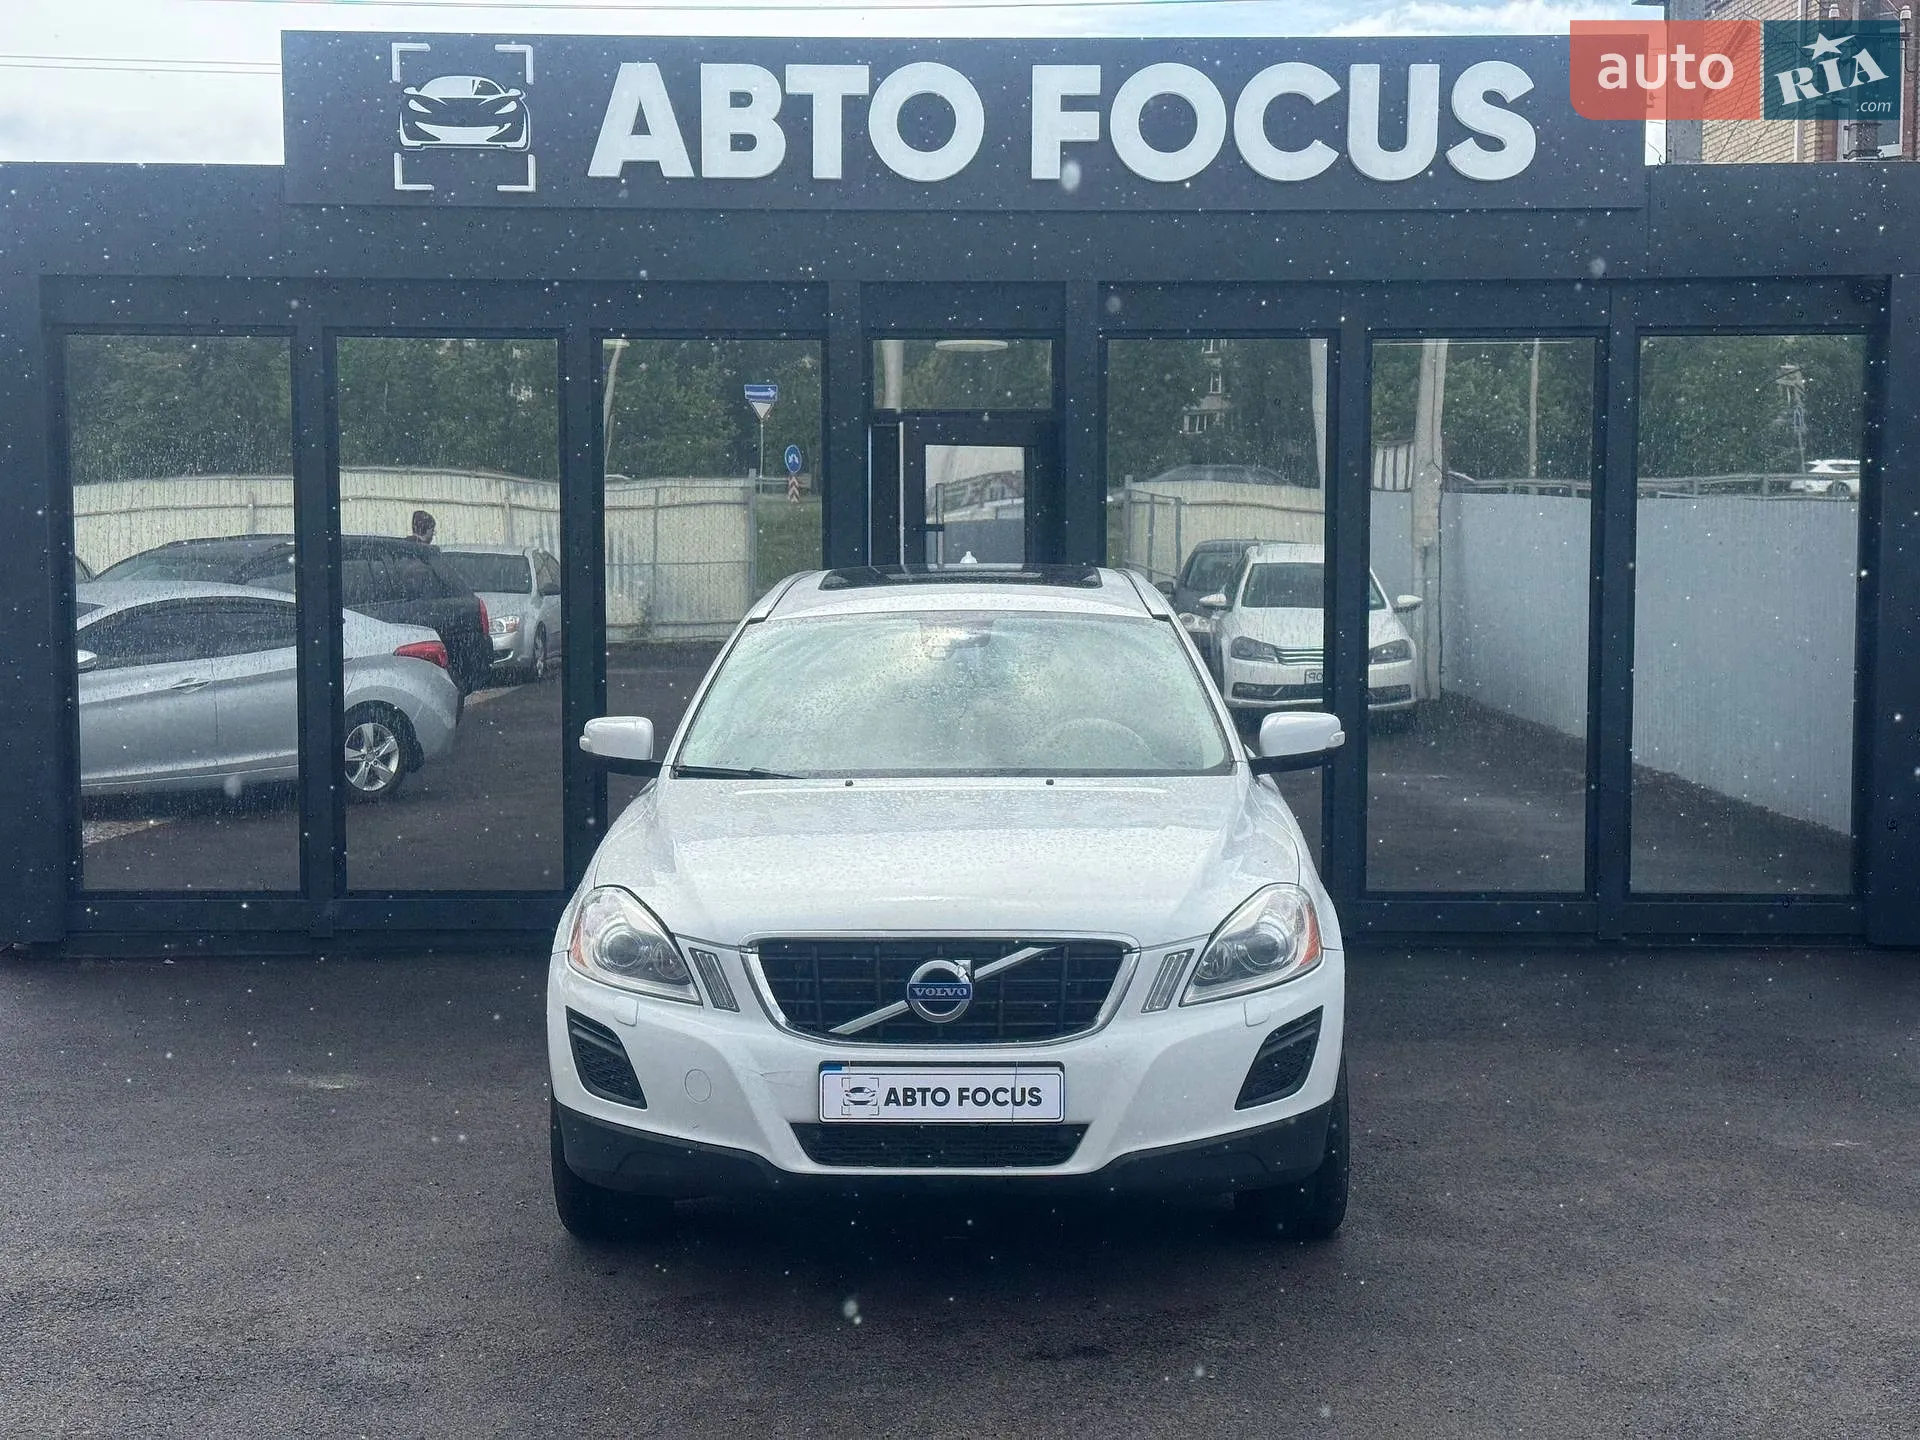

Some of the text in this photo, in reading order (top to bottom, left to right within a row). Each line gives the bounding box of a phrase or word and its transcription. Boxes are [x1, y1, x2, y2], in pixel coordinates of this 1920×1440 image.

[587, 61, 1537, 182] АВТО FOCUS
[911, 987, 968, 996] VOLVO
[884, 1086, 1043, 1107] АВТО FOCUS
